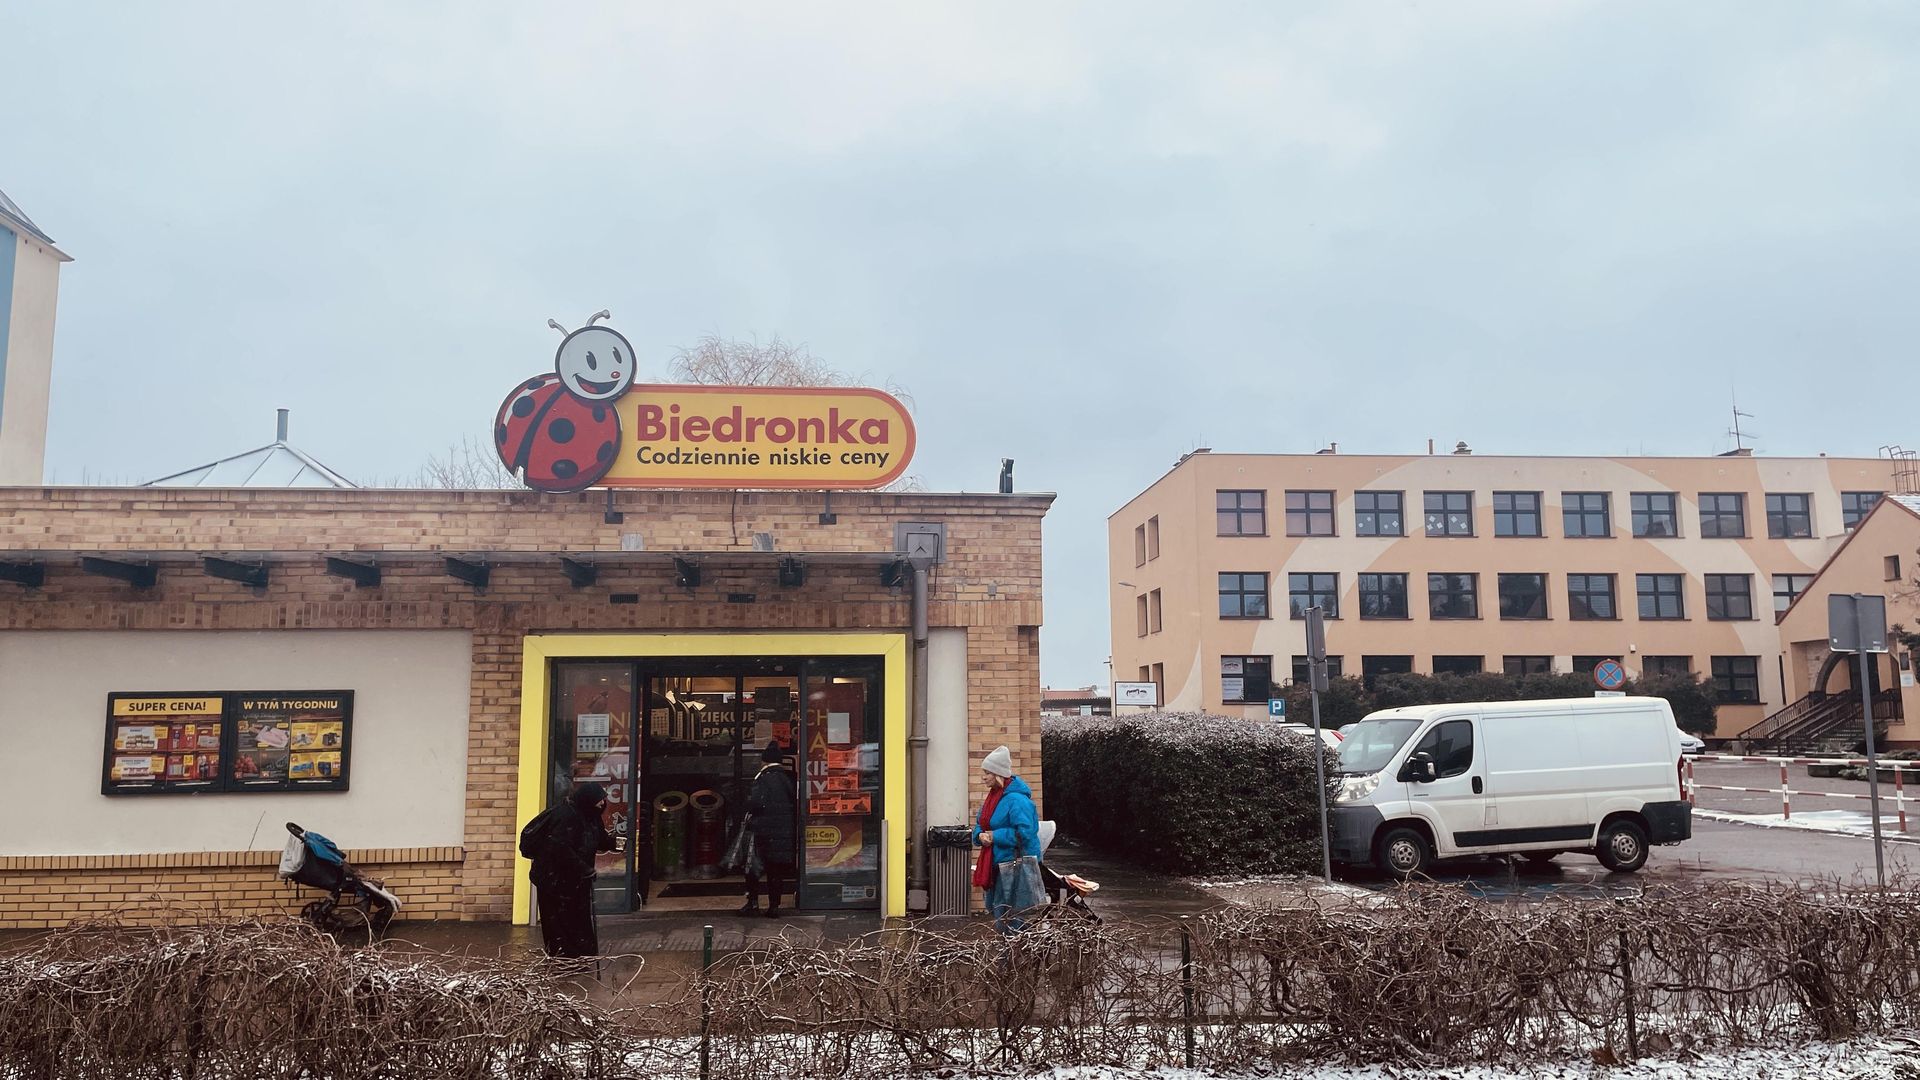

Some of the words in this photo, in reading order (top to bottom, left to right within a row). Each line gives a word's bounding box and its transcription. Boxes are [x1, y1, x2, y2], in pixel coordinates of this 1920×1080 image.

[637, 404, 889, 444] Biedronka
[636, 446, 760, 465] Codziennie
[769, 448, 831, 465] niskie
[840, 452, 890, 468] ceny
[128, 702, 166, 711] SUPER
[170, 701, 206, 711] CENA!
[243, 701, 254, 709] W
[257, 701, 279, 709] TYM
[282, 700, 338, 709] TYGODNIU
[1272, 701, 1282, 713] P
